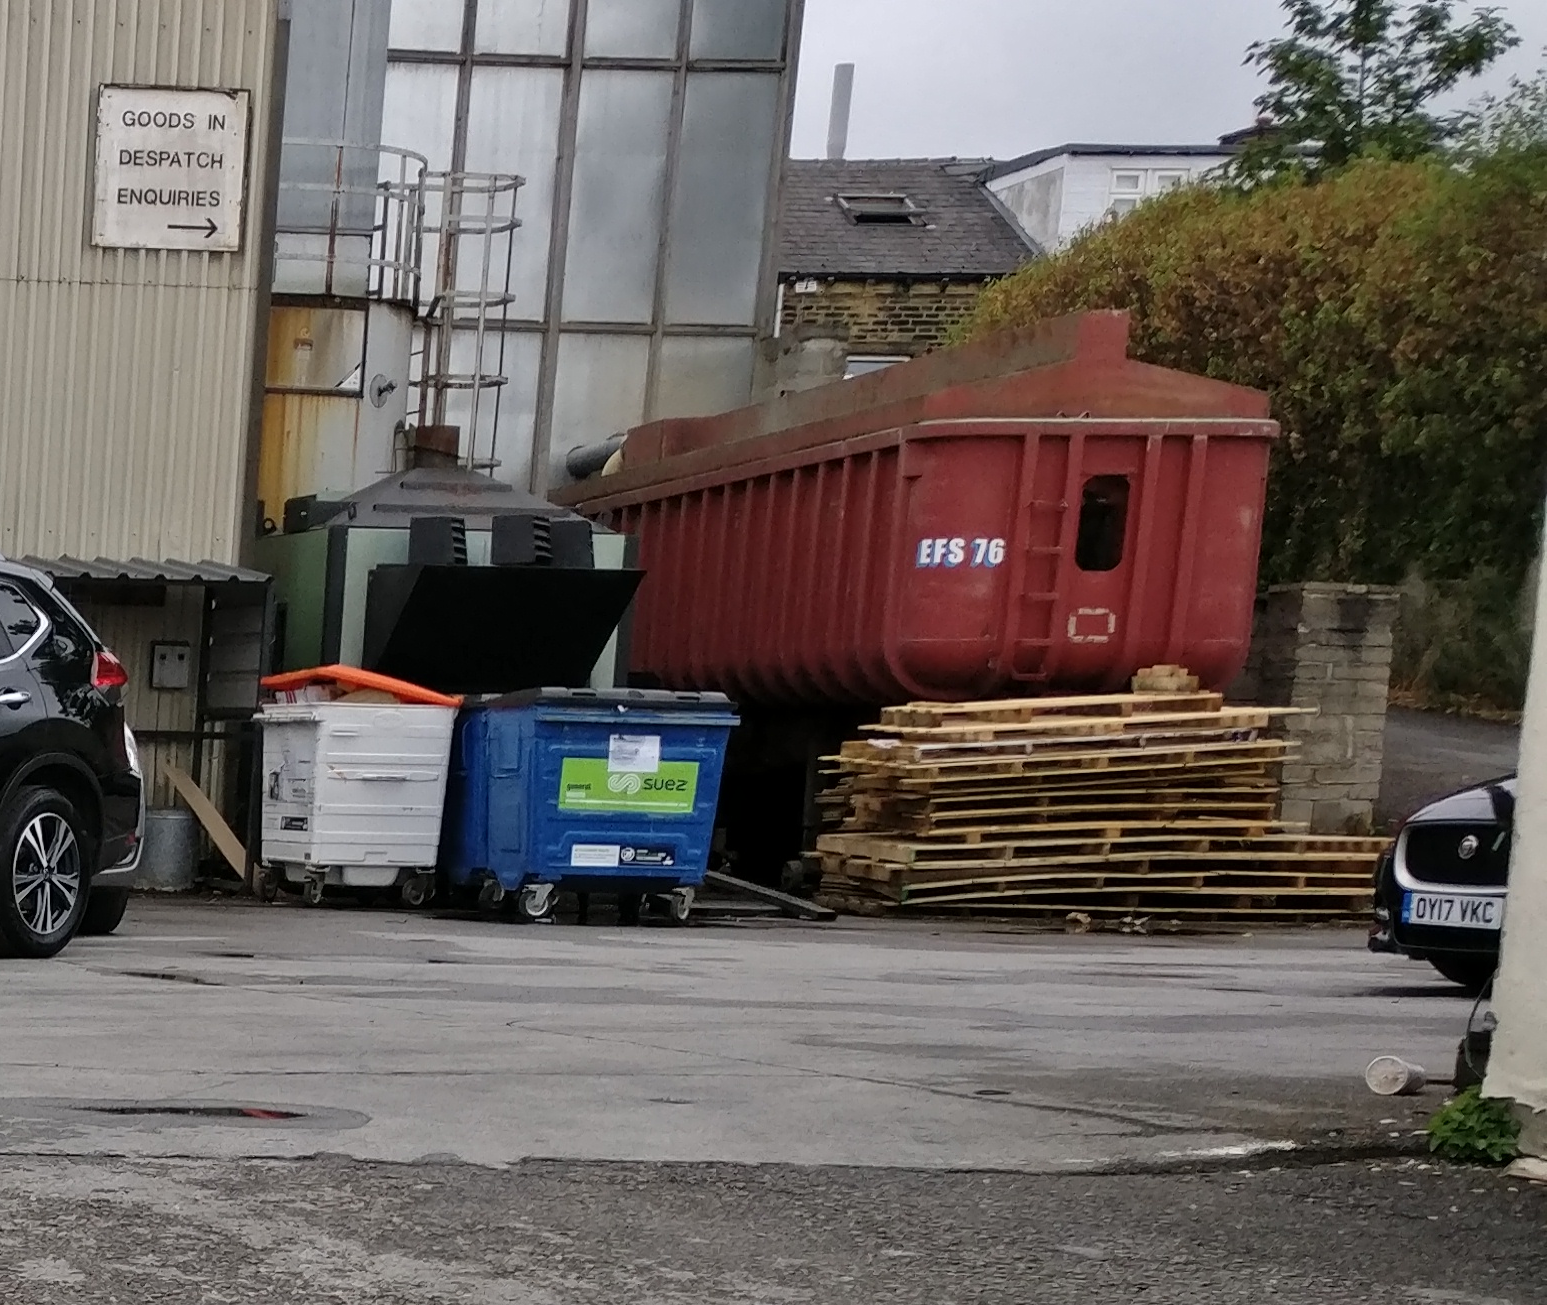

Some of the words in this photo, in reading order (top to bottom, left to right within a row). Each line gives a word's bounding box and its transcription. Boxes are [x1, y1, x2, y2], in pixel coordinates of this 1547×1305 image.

[121, 110, 196, 130] GOODS
[208, 114, 226, 131] IN
[119, 149, 224, 169] DESPATCH
[117, 188, 221, 207] ENQUIRIES
[916, 536, 966, 567] EFS
[970, 536, 1006, 567] 76
[643, 778, 688, 792] suez
[1416, 896, 1455, 921] OY17
[1460, 900, 1495, 924] VKC
